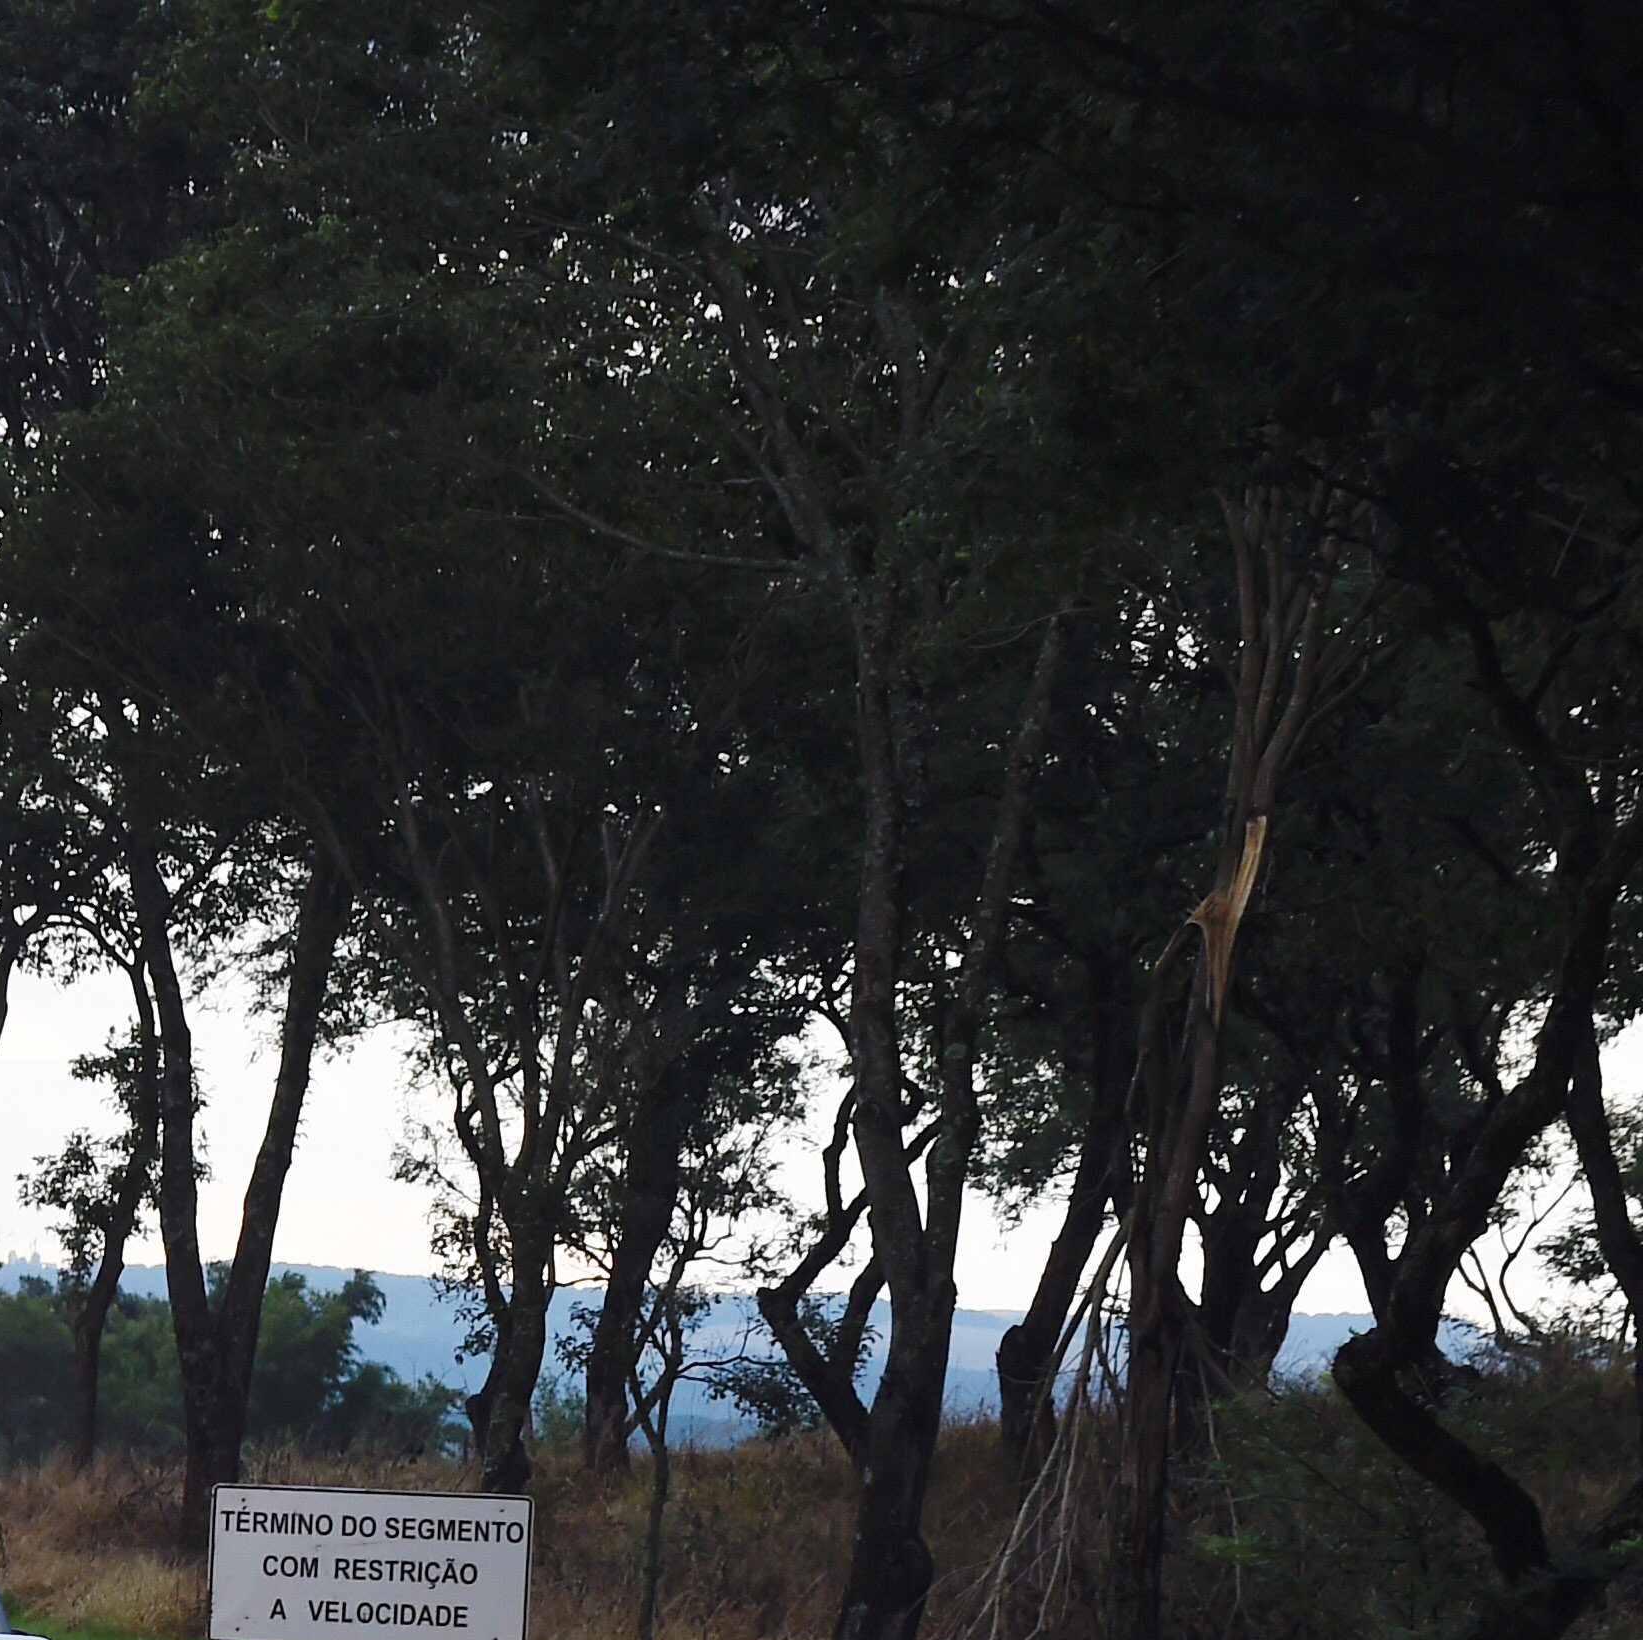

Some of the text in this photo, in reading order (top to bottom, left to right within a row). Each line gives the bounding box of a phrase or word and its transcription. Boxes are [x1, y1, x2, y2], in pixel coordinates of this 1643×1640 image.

[220, 1505, 524, 1544] TÉRMINO DO SEGMENTO
[263, 1555, 478, 1590] COM RESTRIÇÃO
[269, 1598, 469, 1628] A VELOCIDADE
